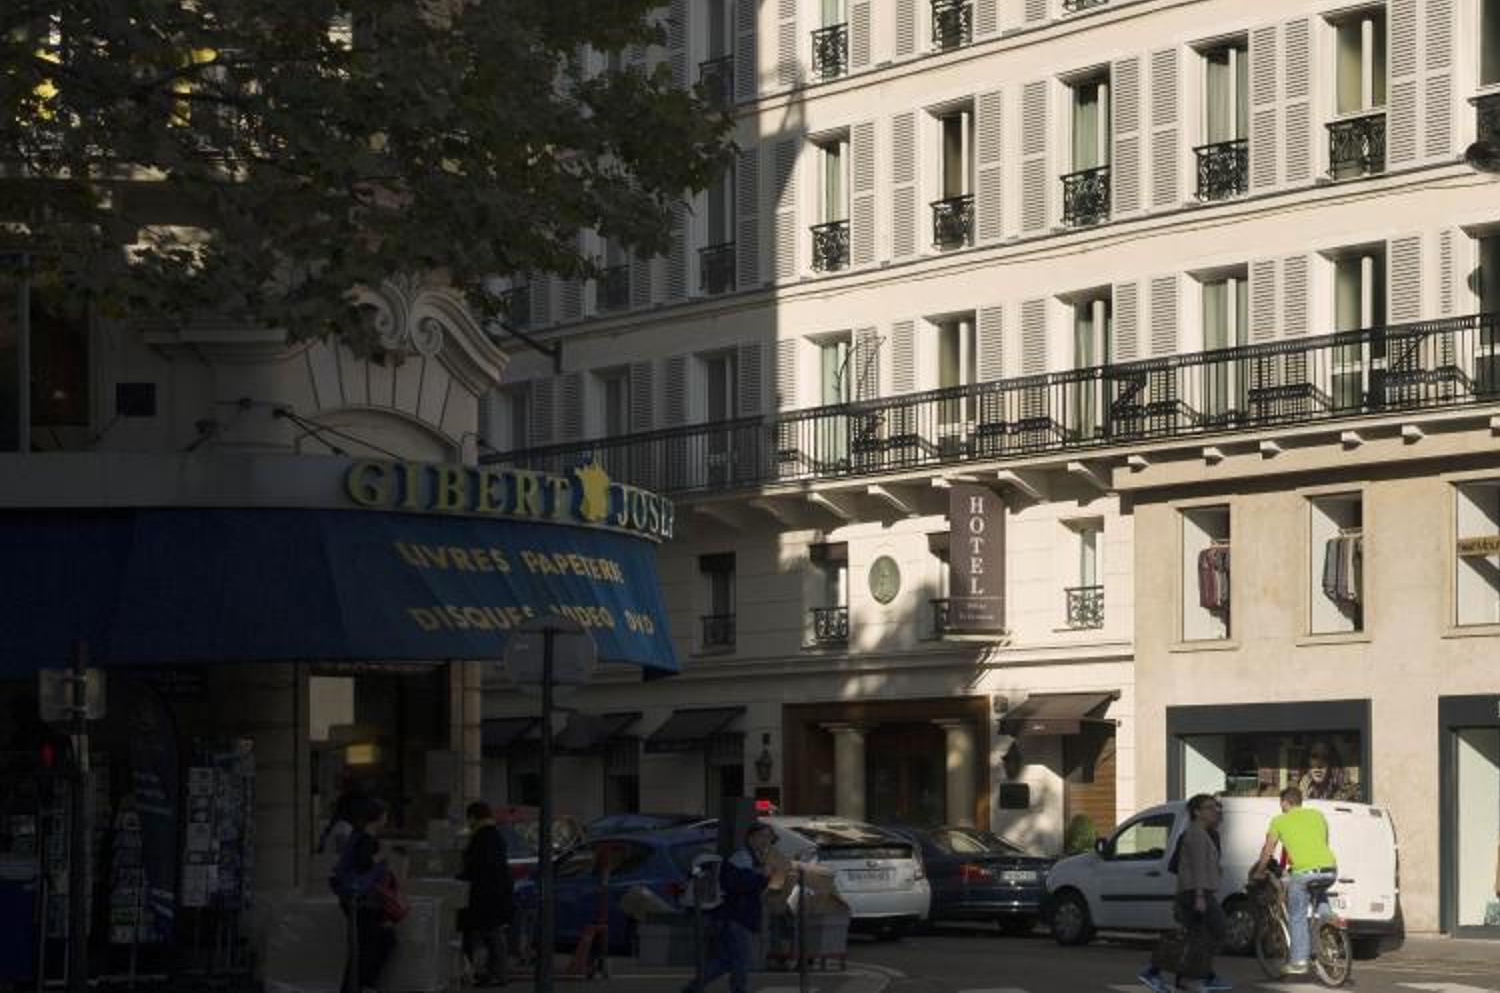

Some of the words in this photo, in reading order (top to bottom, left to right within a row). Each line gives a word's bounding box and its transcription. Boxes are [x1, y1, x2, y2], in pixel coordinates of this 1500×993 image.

[349, 461, 570, 518] GIBERT
[394, 542, 513, 575] LIVRES
[969, 495, 985, 595] HOTEL
